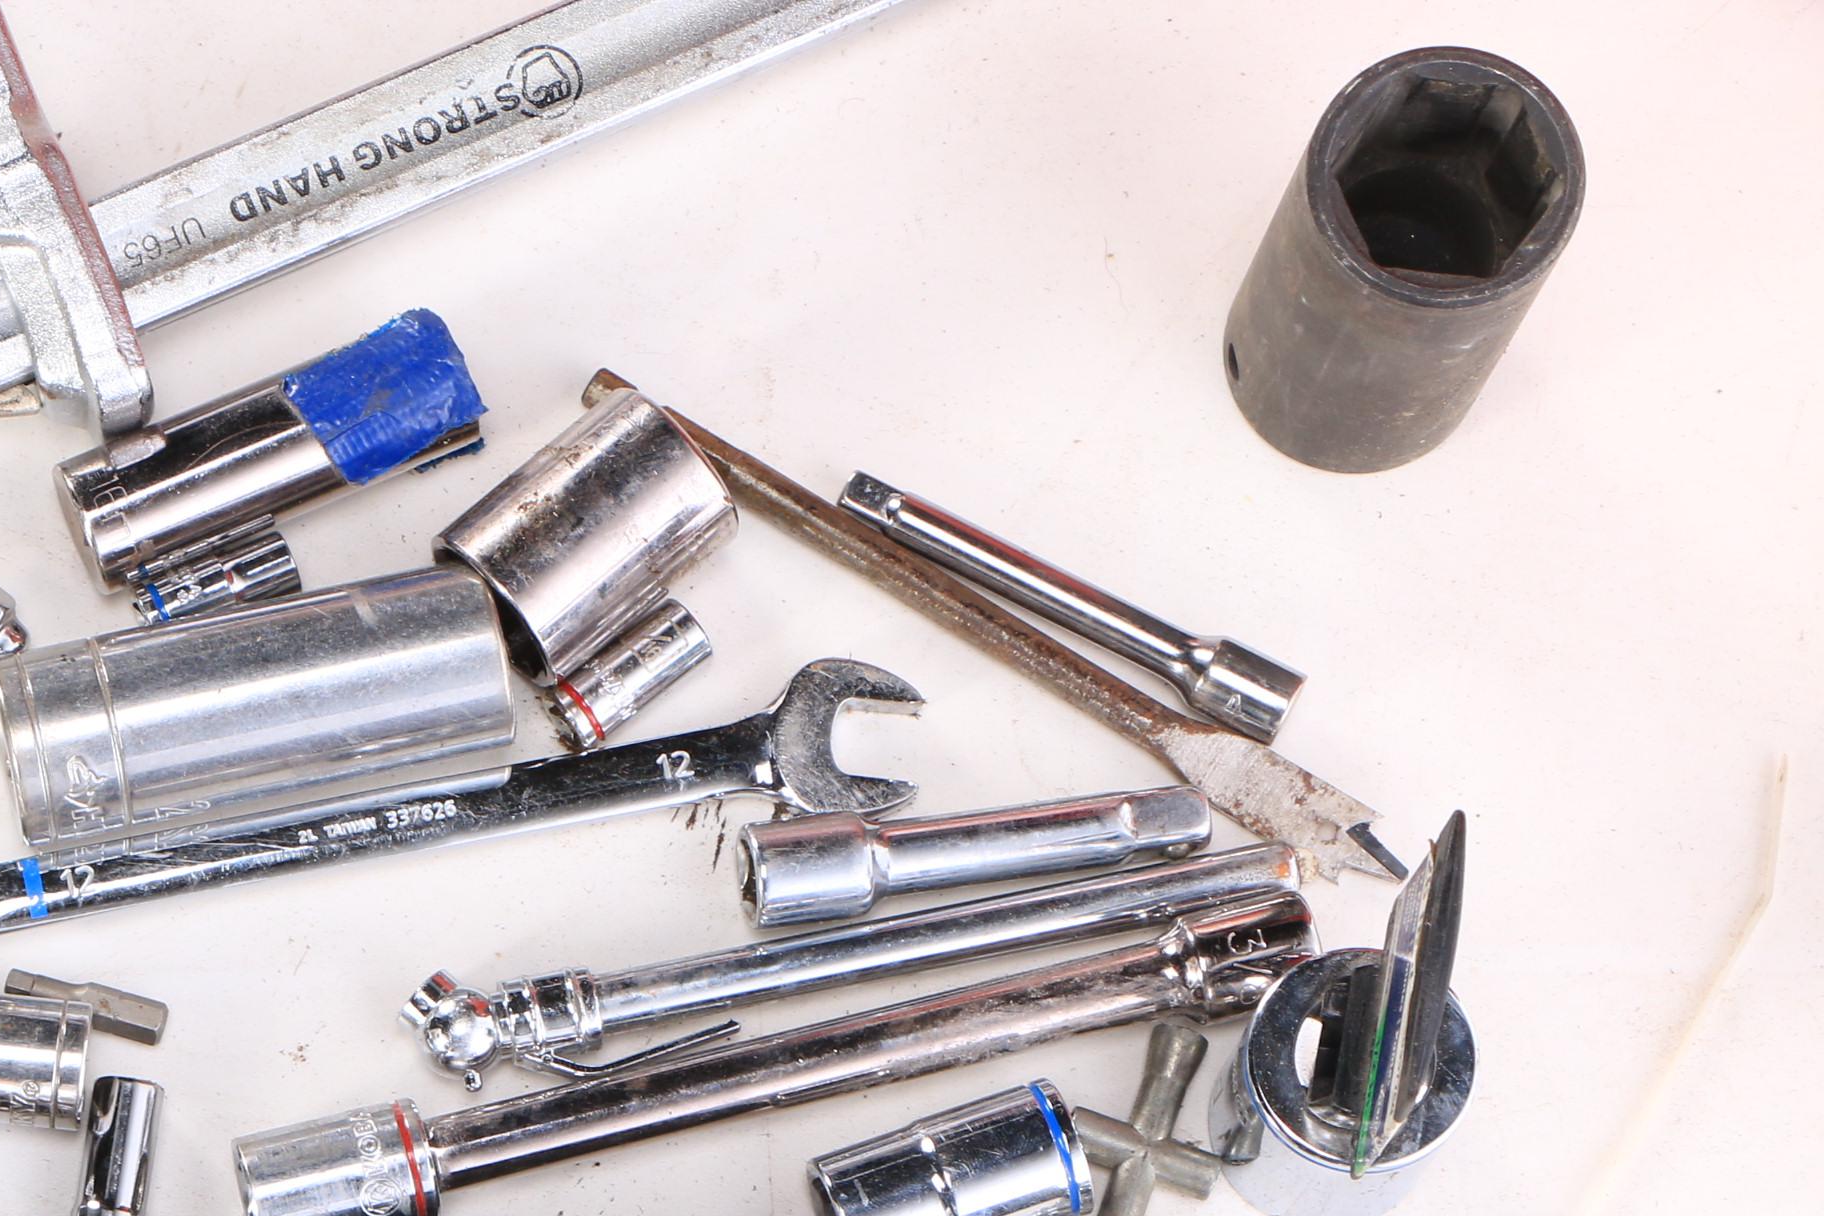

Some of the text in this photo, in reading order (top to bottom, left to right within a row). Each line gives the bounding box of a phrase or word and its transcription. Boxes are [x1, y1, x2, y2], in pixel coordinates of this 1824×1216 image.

[229, 81, 522, 223] STRONG HAND
[123, 216, 207, 269] UF65
[656, 751, 696, 780] 12
[384, 799, 458, 830] 337626
[61, 865, 96, 896] 12
